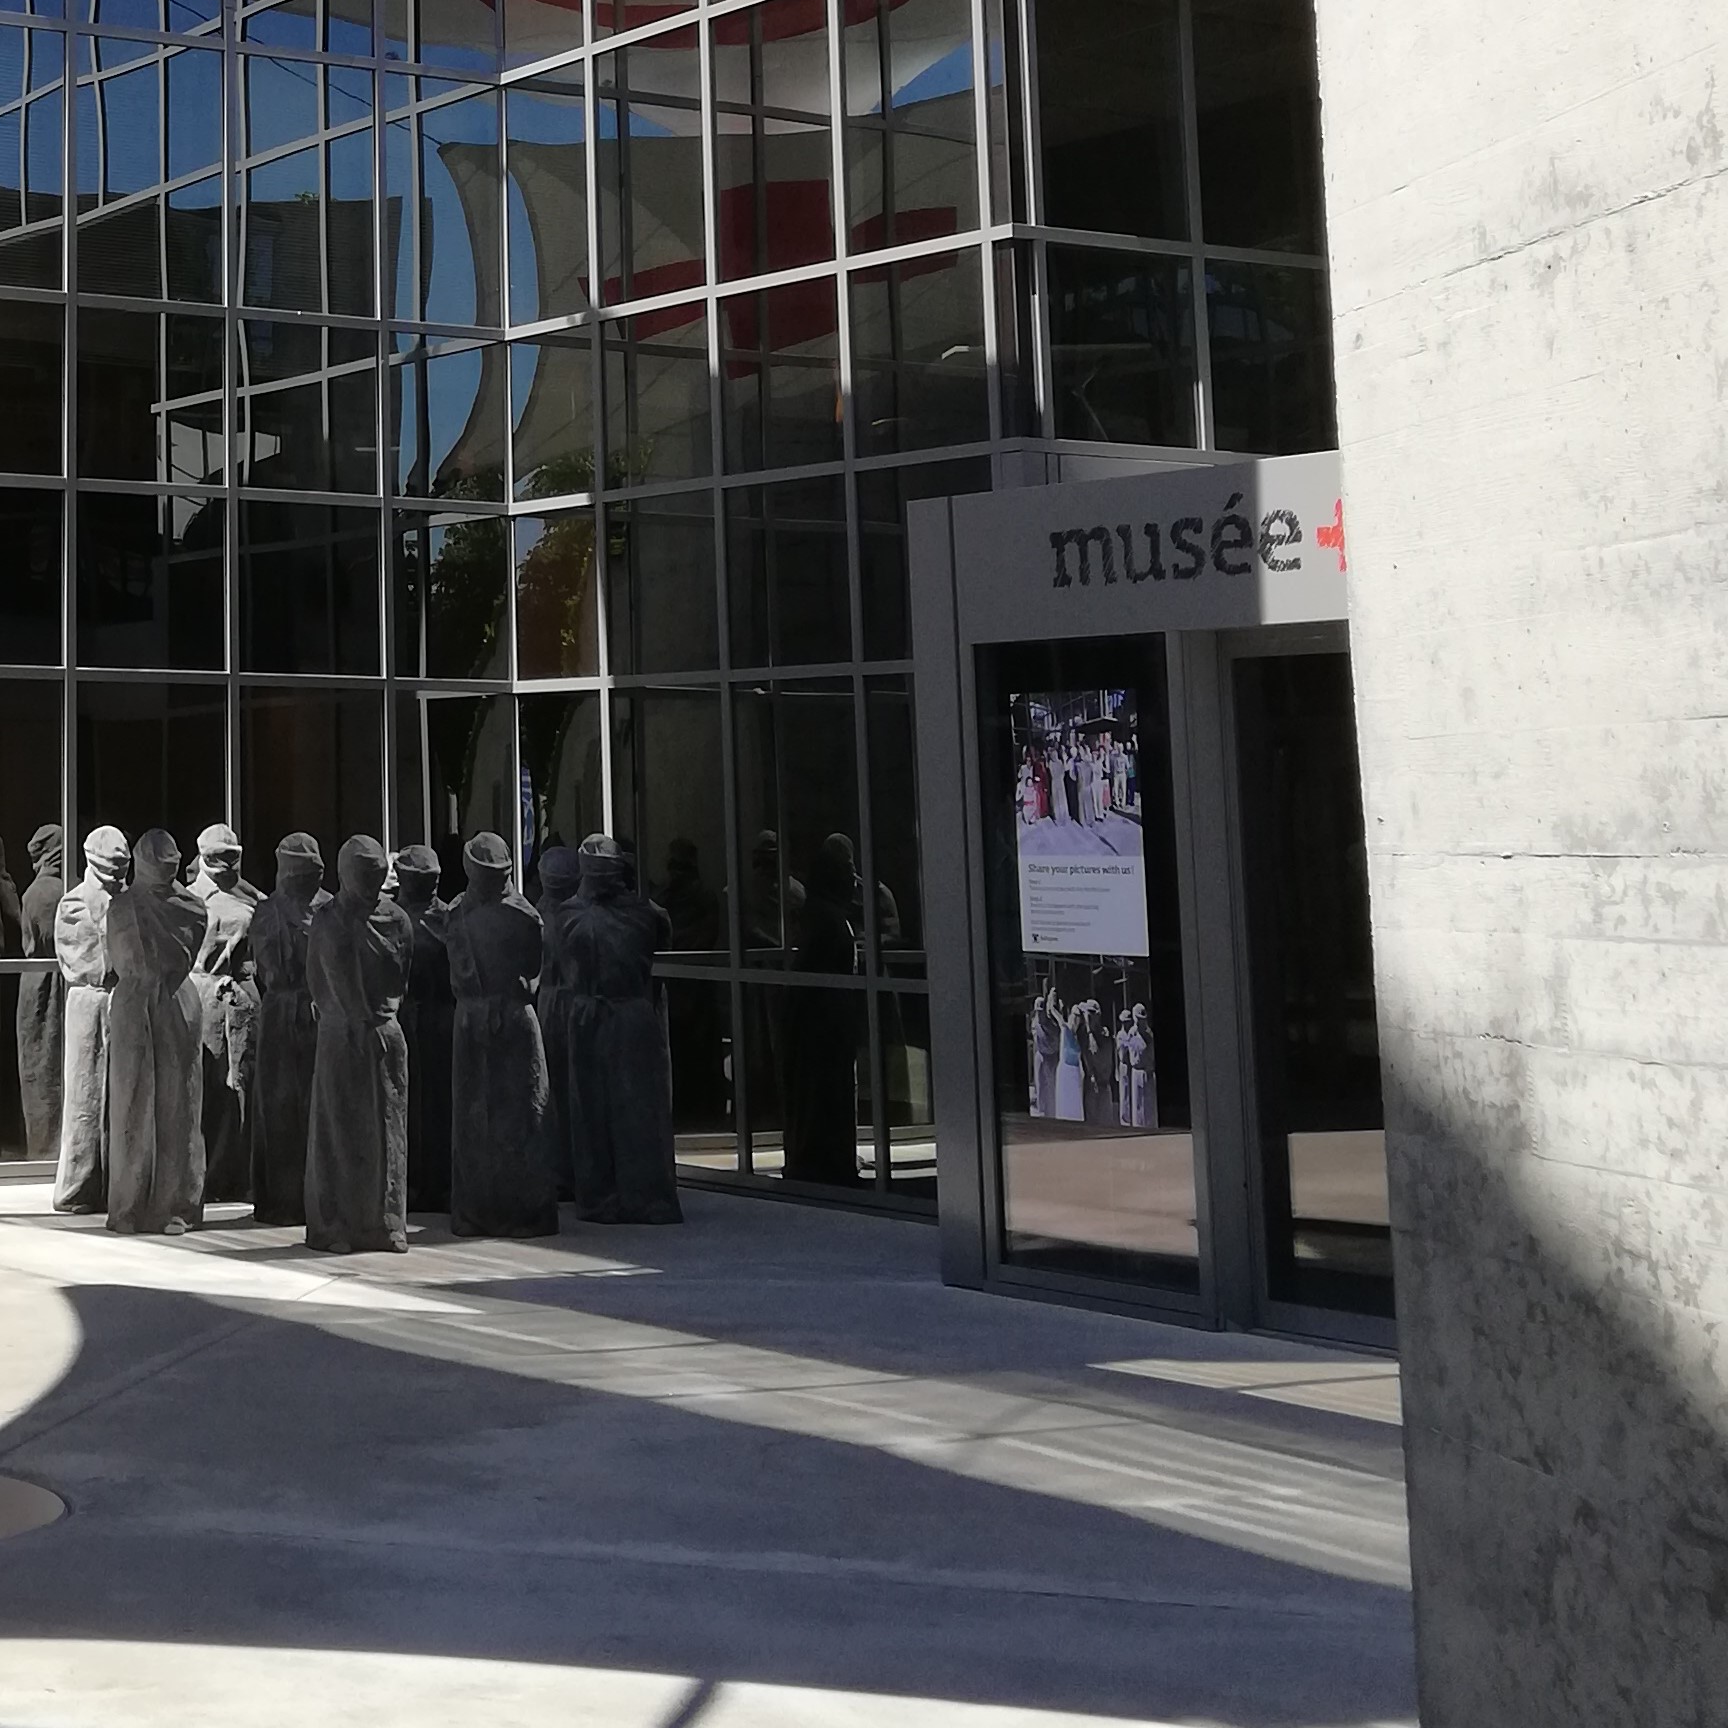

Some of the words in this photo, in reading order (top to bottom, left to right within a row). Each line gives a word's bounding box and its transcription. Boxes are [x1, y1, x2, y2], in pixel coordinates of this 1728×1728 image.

[1049, 492, 1303, 588] musée
[1028, 864, 1050, 874] Share
[1051, 865, 1068, 876] your
[1069, 865, 1101, 876] pictures
[1102, 865, 1120, 874] with
